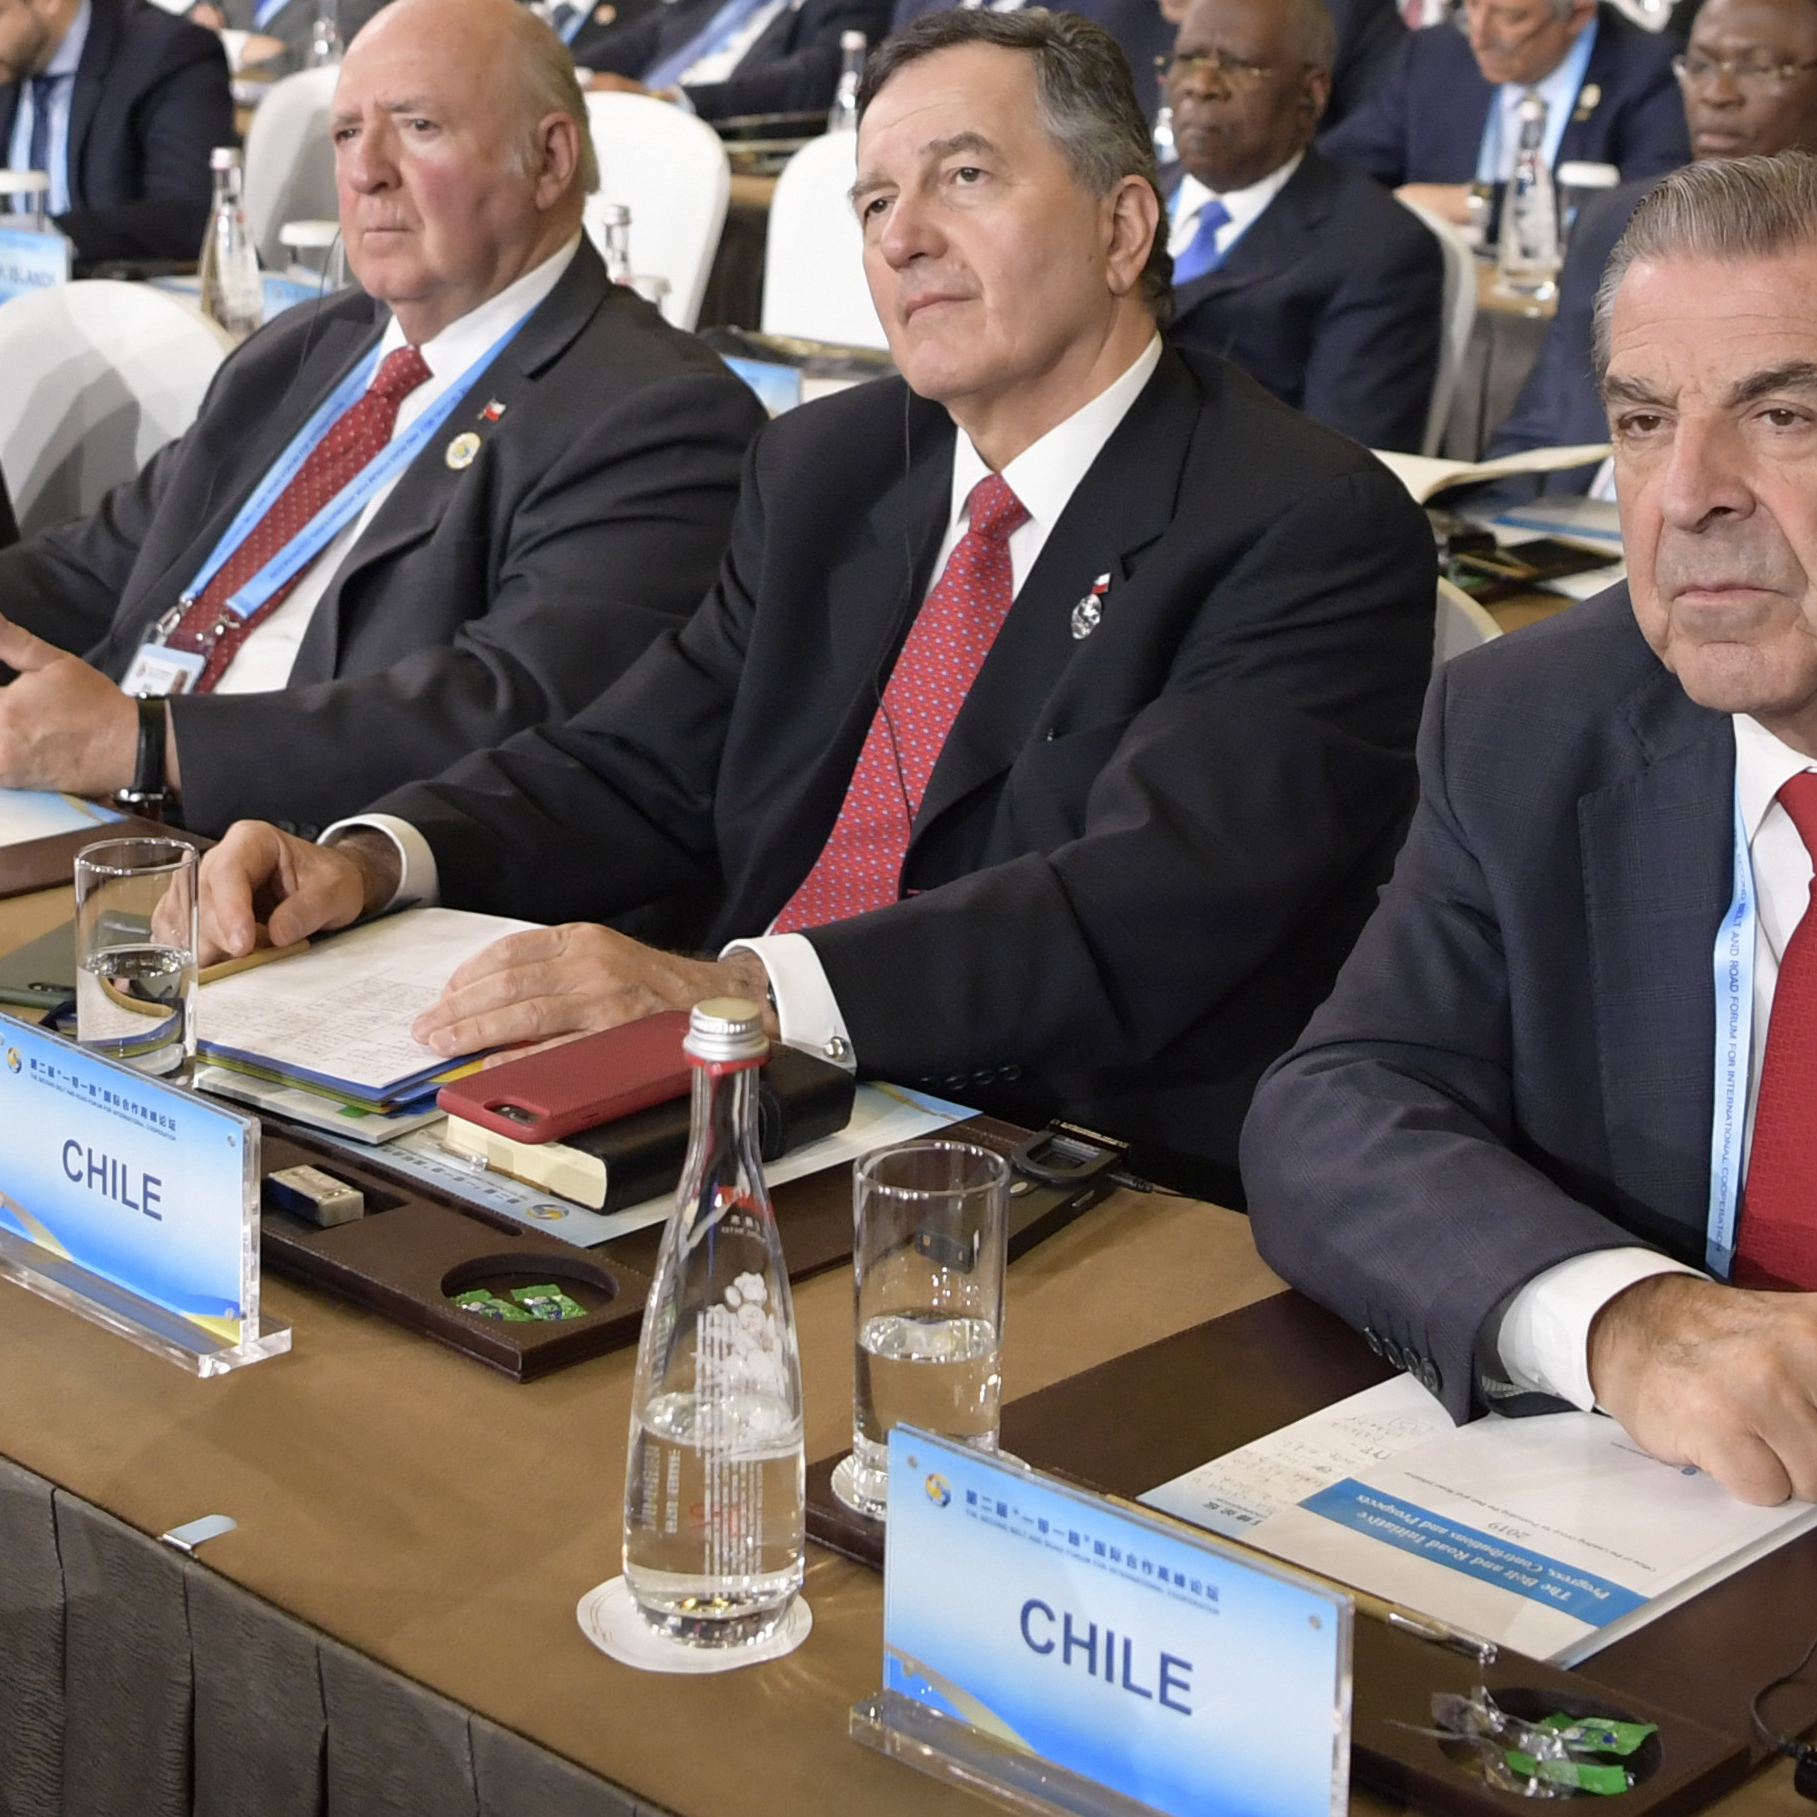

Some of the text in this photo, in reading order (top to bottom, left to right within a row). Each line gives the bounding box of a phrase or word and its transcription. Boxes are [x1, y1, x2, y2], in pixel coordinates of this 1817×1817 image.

[1729, 931, 1739, 955] AND
[1728, 960, 1739, 993] ROAD
[1728, 996, 1740, 1040] FORUM
[1727, 1043, 1737, 1067] FOR
[1721, 1070, 1735, 1164] INTERNATIONAL
[62, 1139, 163, 1221] CHILE
[1715, 1167, 1729, 1253] COOPERATION
[1355, 1494, 1420, 1525] Prospects
[1419, 1519, 1449, 1536] and
[1448, 1531, 1544, 1573] Contributions
[1487, 1521, 1531, 1541] 2019
[1356, 1510, 1572, 1601] The Belt and Road Initiative
[1020, 1598, 1193, 1716] CHILE
